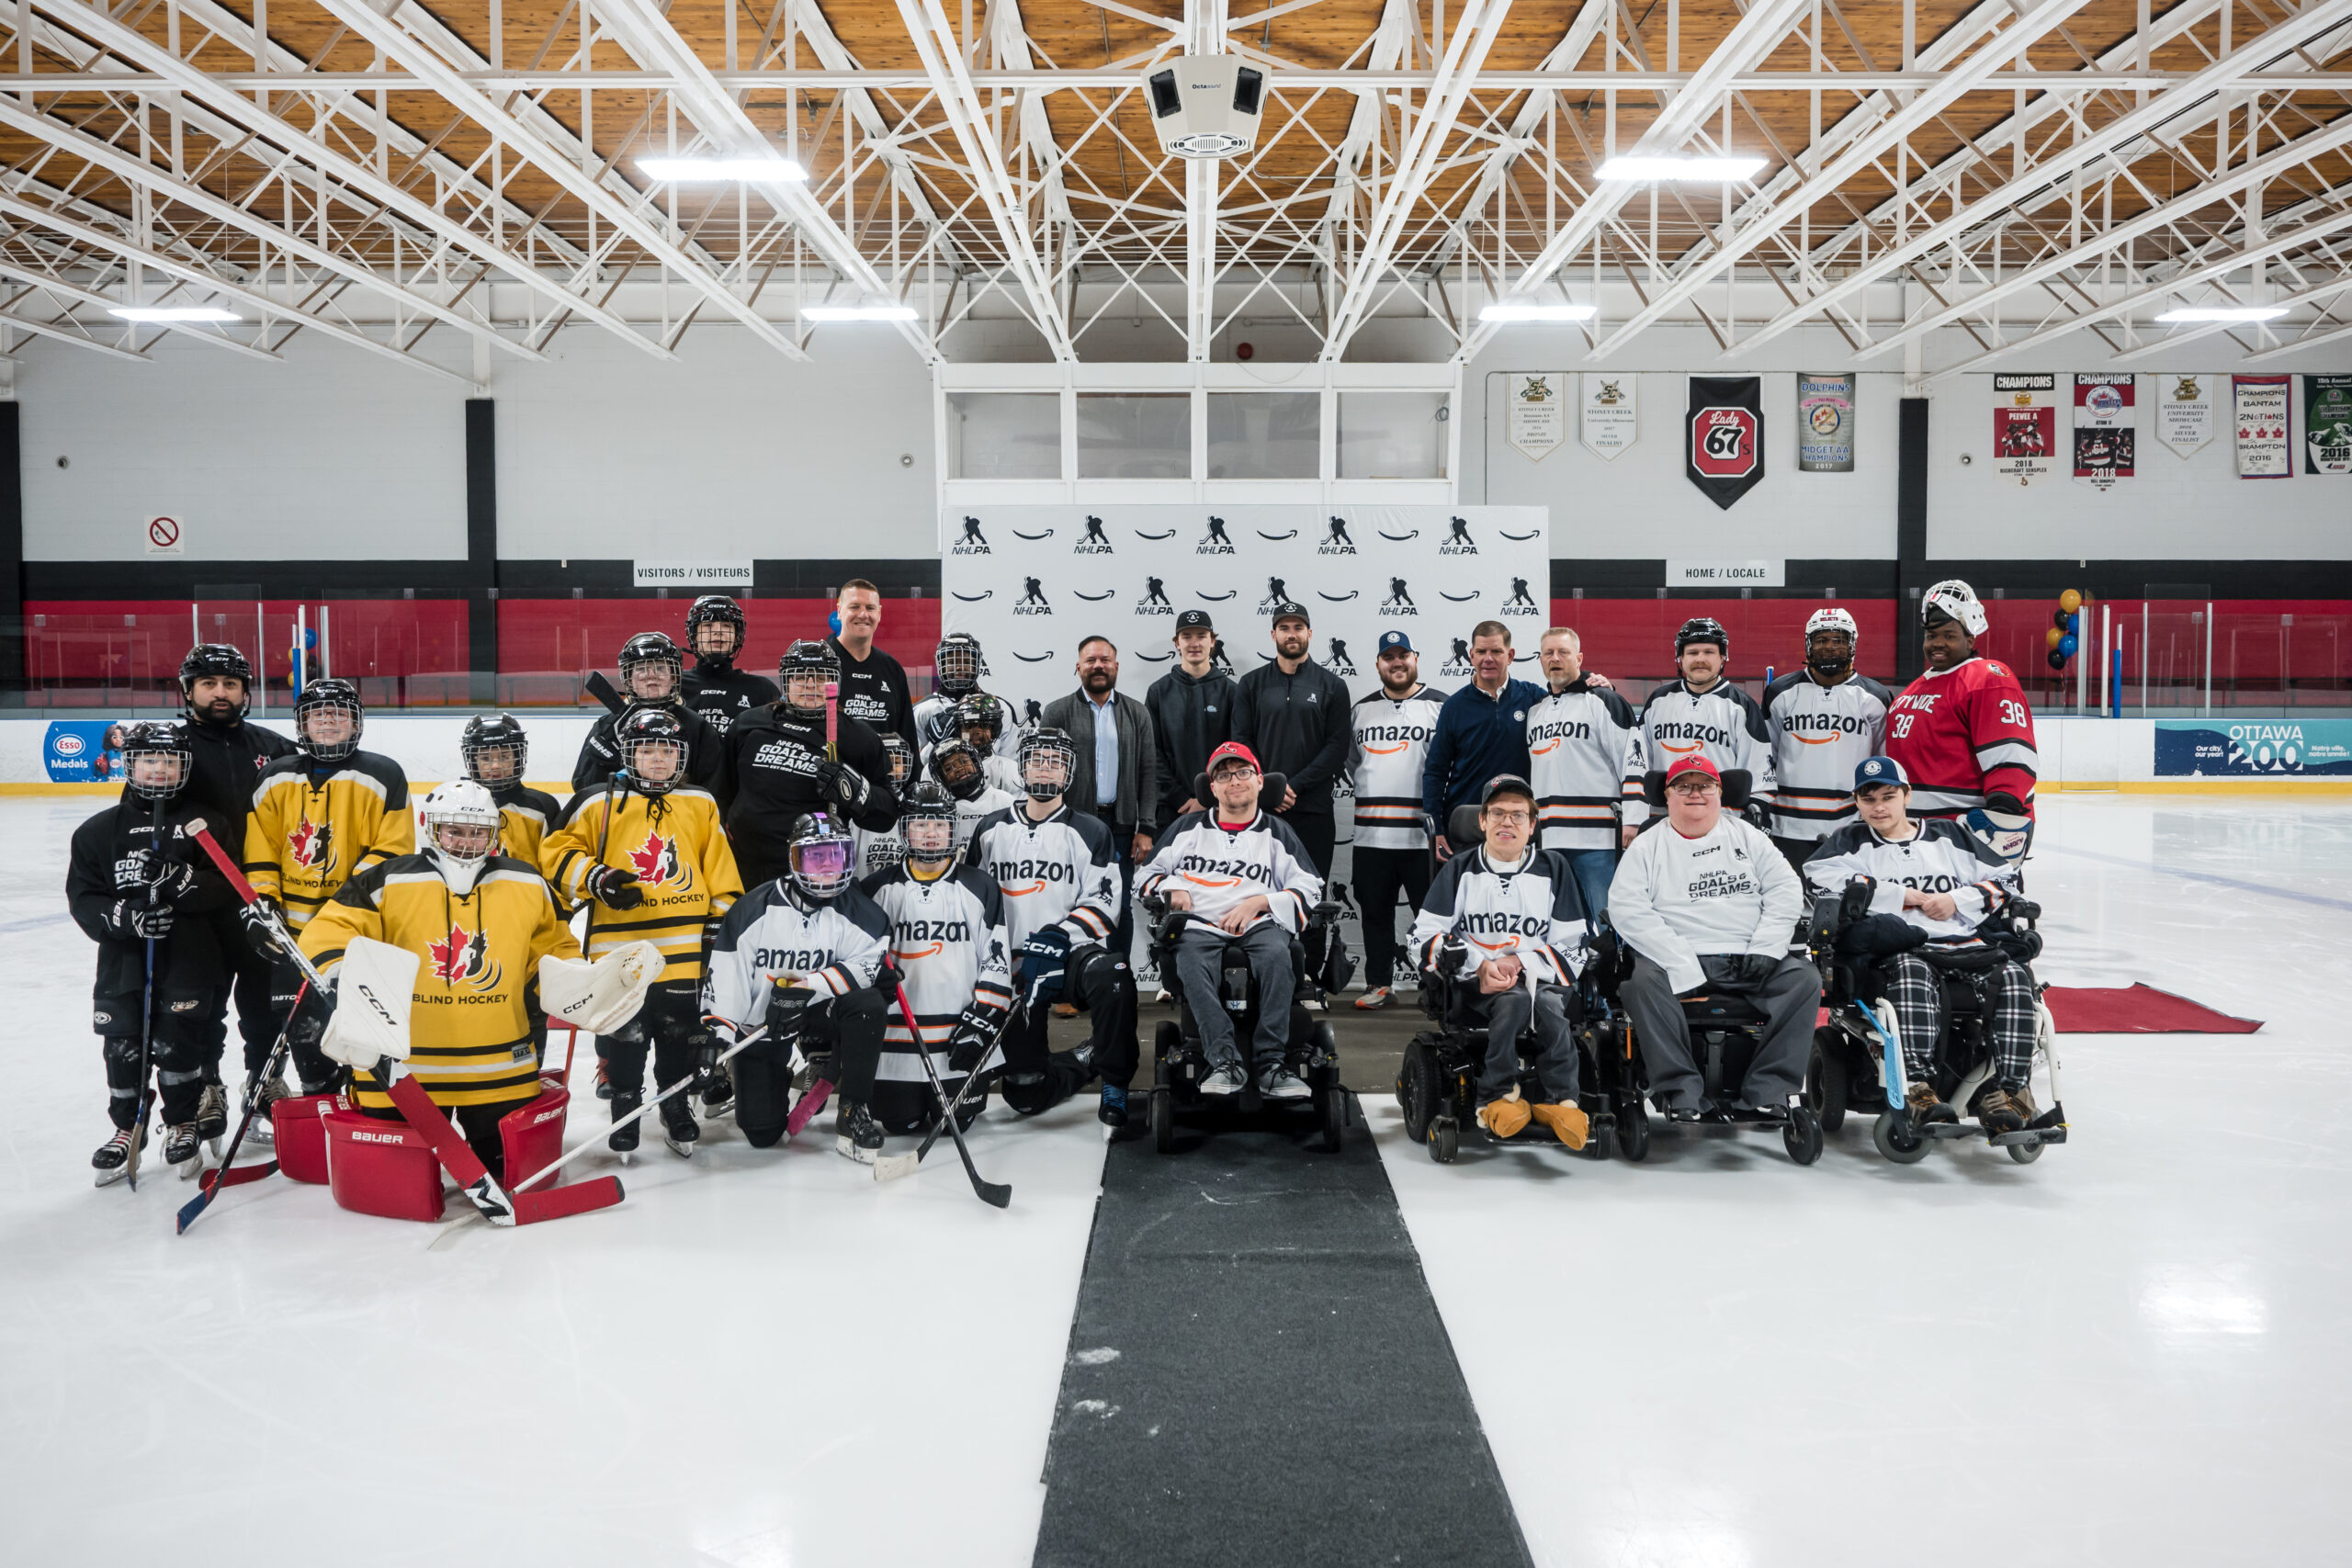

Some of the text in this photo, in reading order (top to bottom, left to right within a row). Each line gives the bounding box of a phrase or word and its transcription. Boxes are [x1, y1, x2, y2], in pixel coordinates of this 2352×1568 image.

[1996, 377, 2052, 388] CHAMPIONS
[2078, 374, 2132, 385] CHAMPIONS
[1802, 383, 1850, 392] DOLPHINS
[1709, 411, 1740, 427] Lady
[2008, 412, 2031, 421] PEEWEE
[1801, 446, 1849, 454] MIDGET AA
[2321, 447, 2350, 457] 2016
[2091, 468, 2116, 478] 2018
[952, 546, 990, 555] NHLPA
[1073, 546, 1113, 555] NHLPA
[1195, 546, 1235, 555] NHLPA
[1317, 546, 1356, 555] NHLPA
[1439, 546, 1478, 555] NHLPA
[638, 568, 685, 578] VISITORS
[696, 568, 751, 578] VISITEURS
[1685, 568, 1715, 579] HOME
[1726, 568, 1766, 579] LOCALE
[1012, 606, 1053, 615] NHLPA
[1136, 606, 1174, 615] NHLPA
[1378, 606, 1419, 615] NHLPA
[1500, 606, 1540, 615] NHLPA
[845, 699, 877, 709] GOALS
[844, 707, 888, 718] DREAMS
[1998, 699, 2028, 728] 38
[782, 722, 812, 733] CCM
[1783, 712, 1868, 737] amazon
[1891, 713, 1915, 739] 38
[1654, 721, 1731, 749] amazon
[2229, 725, 2304, 740] OTTAWA
[59, 740, 81, 750] Esso
[775, 739, 807, 752] NHLPA
[759, 744, 812, 762] GOALS
[2228, 740, 2304, 772] 200
[51, 759, 89, 769] Medals
[753, 752, 818, 773] DREAMS
[1691, 844, 1722, 858] CCM
[114, 870, 142, 885] DRE
[989, 859, 1075, 886] amazon
[1699, 869, 1728, 880] NHLPA
[1688, 875, 1737, 892] GOALS
[1688, 881, 1752, 900] DREAMS
[662, 893, 706, 907] HOCKEY
[895, 919, 972, 943] mazon
[1022, 940, 1065, 958] CCM
[1562, 949, 1588, 965] NHLP
[1136, 974, 1162, 982] NHL
[1393, 973, 1419, 982] HLPA
[358, 984, 397, 1026] CCM
[412, 993, 509, 1006] BLIND HOCKEY
[562, 993, 594, 1014] CCM
[961, 1010, 1000, 1035] CCM
[533, 1105, 564, 1125] BAUER
[351, 1131, 404, 1145] BAUER
